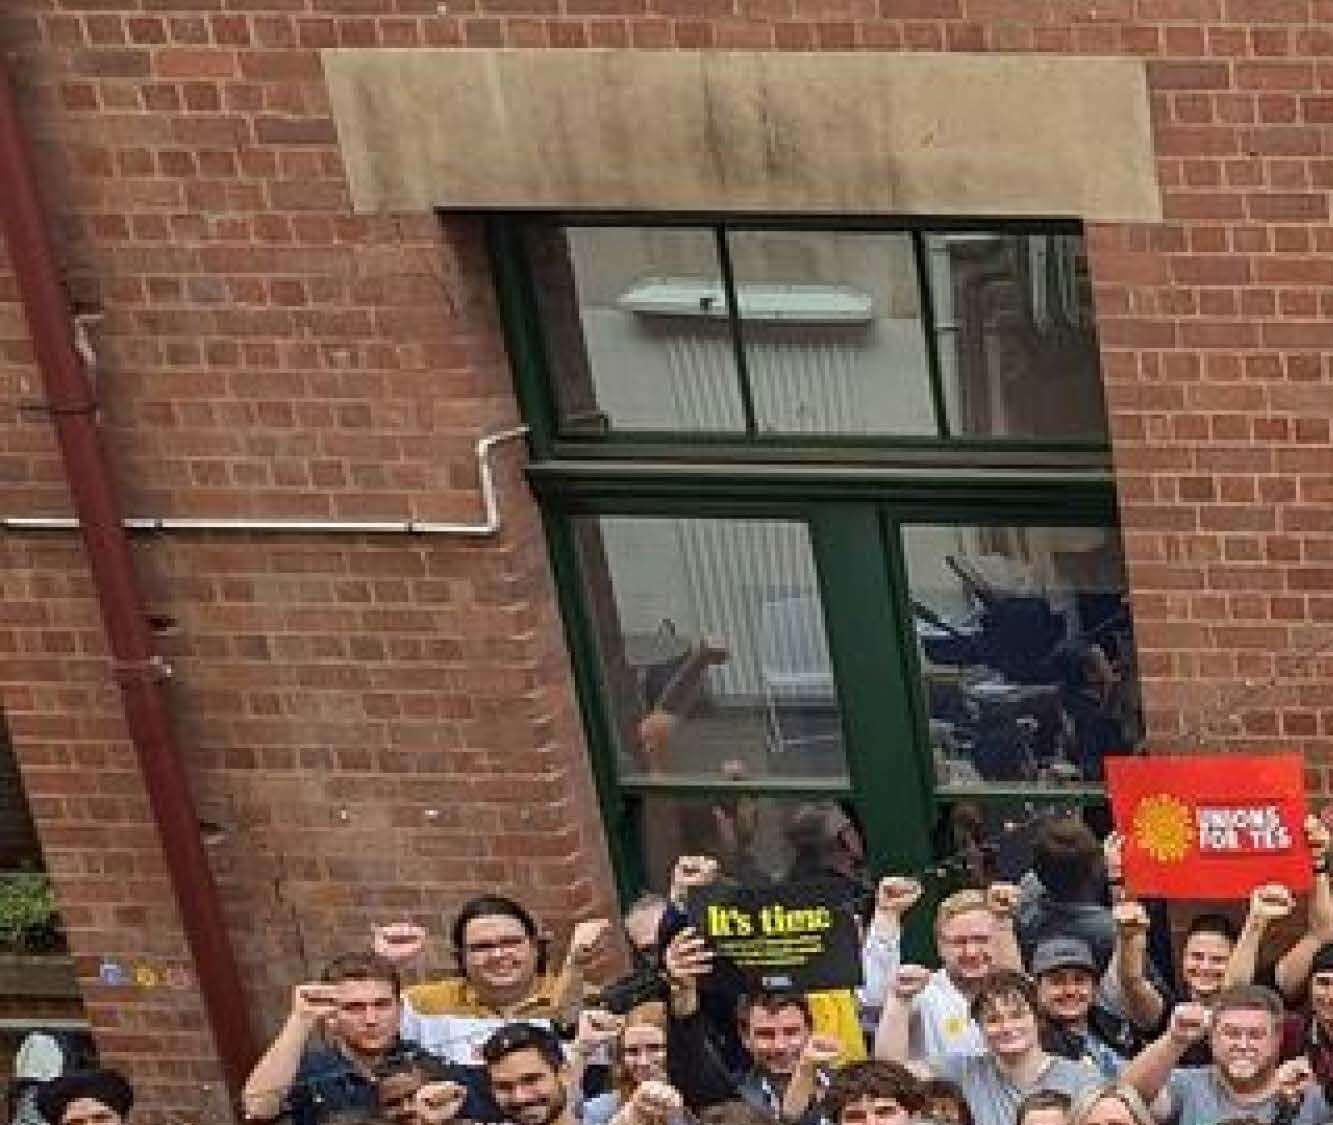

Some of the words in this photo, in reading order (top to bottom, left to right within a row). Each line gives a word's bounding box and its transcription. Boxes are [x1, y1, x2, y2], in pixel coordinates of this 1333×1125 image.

[1196, 805, 1280, 830] UNIONS
[1199, 828, 1239, 850] FOR
[1251, 828, 1293, 850] YES
[707, 904, 753, 937] It's
[760, 903, 832, 933] time
